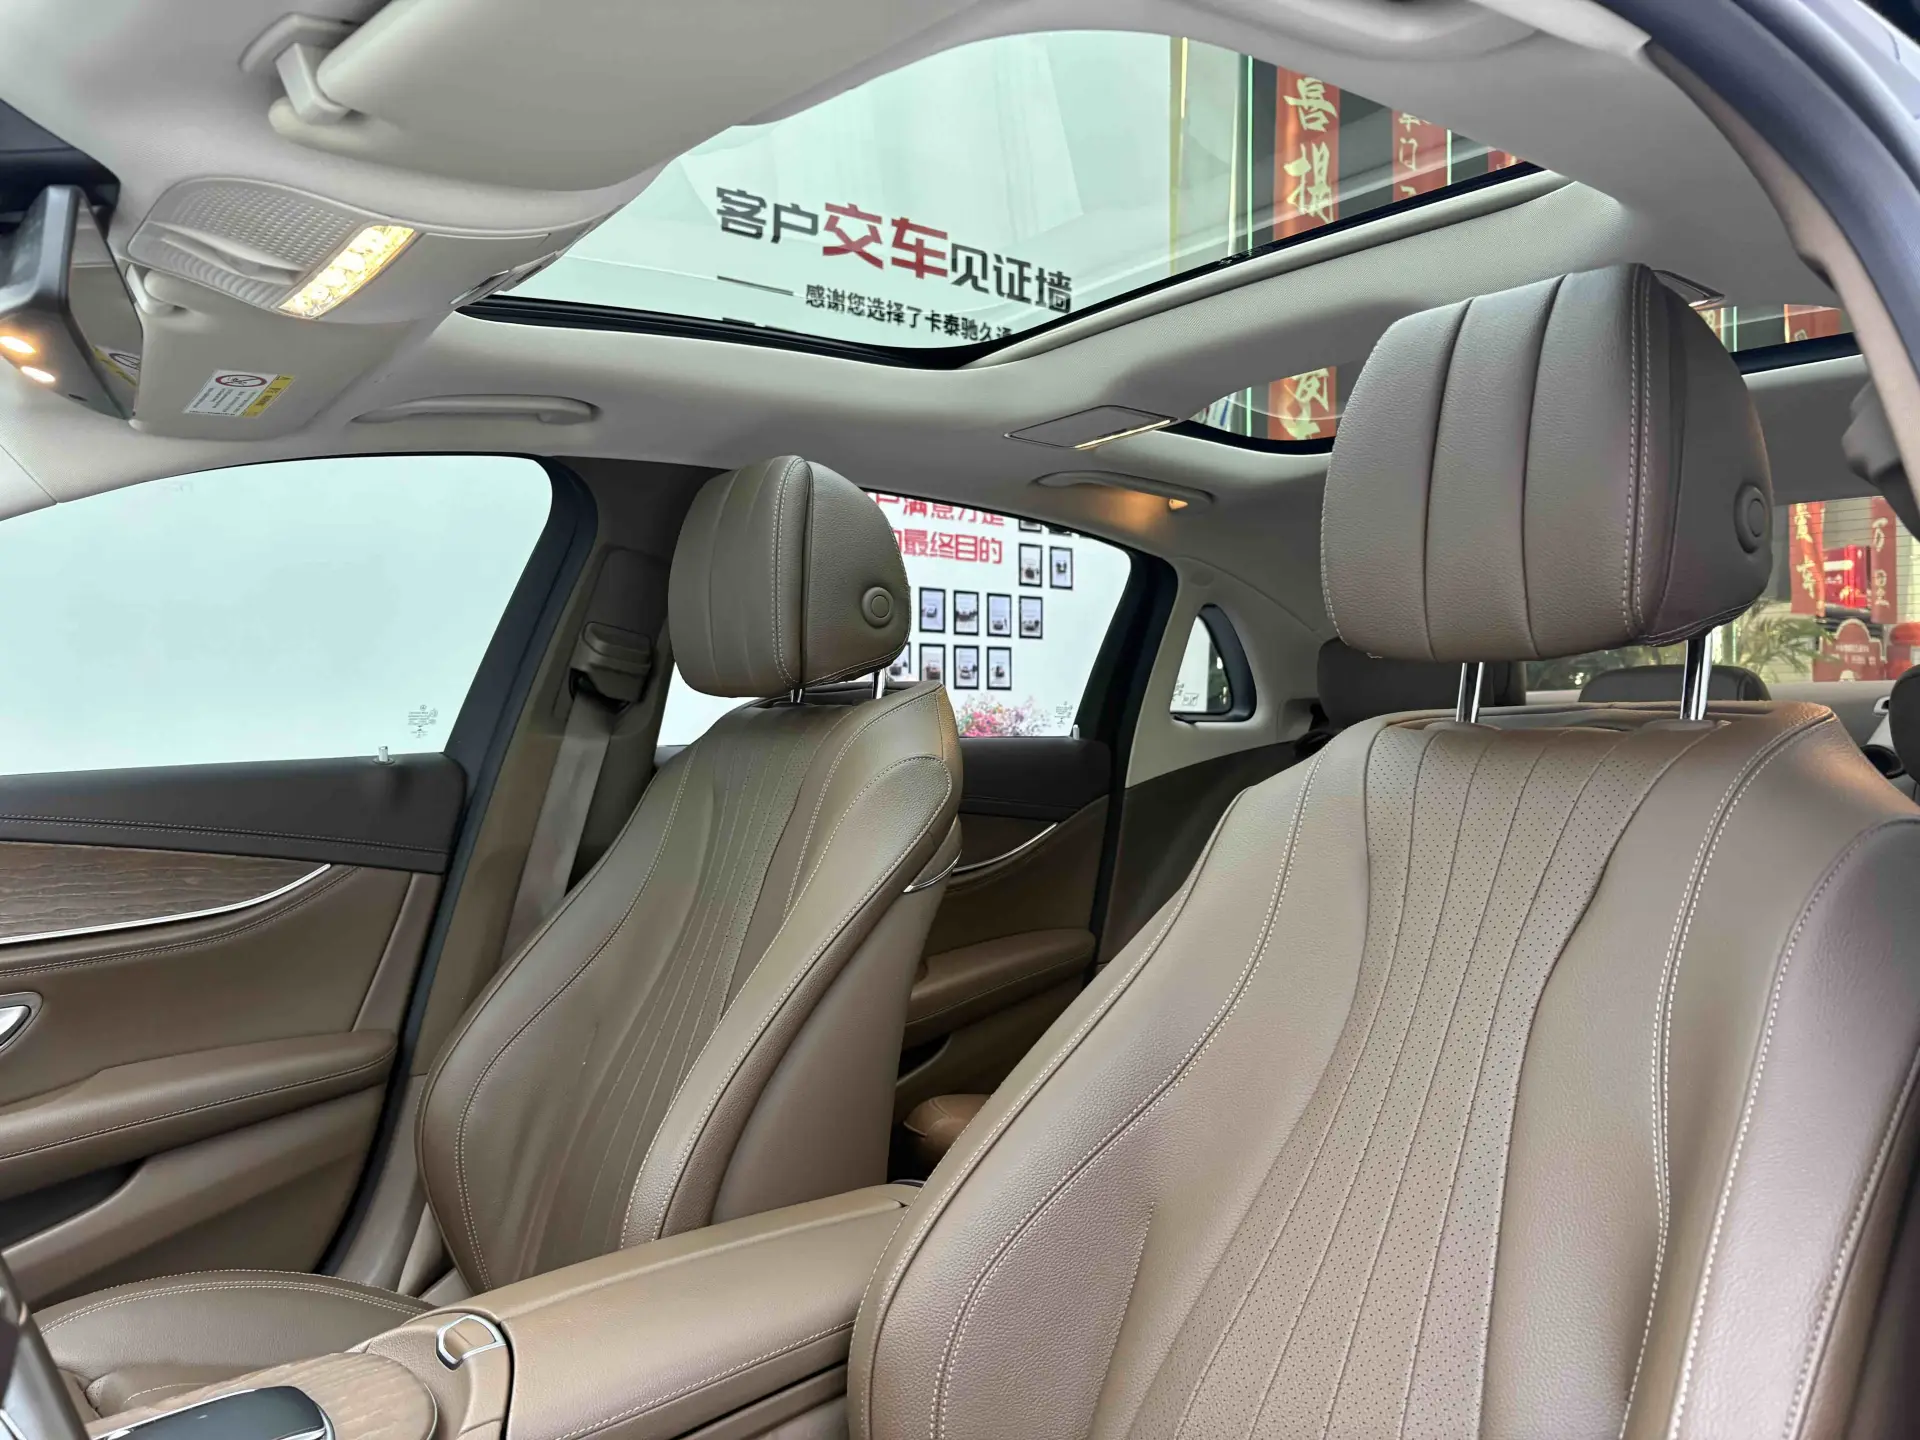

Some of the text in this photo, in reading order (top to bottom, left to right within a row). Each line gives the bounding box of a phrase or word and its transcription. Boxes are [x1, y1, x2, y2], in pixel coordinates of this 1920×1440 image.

[716, 186, 1073, 314] 客户交车见证墙
